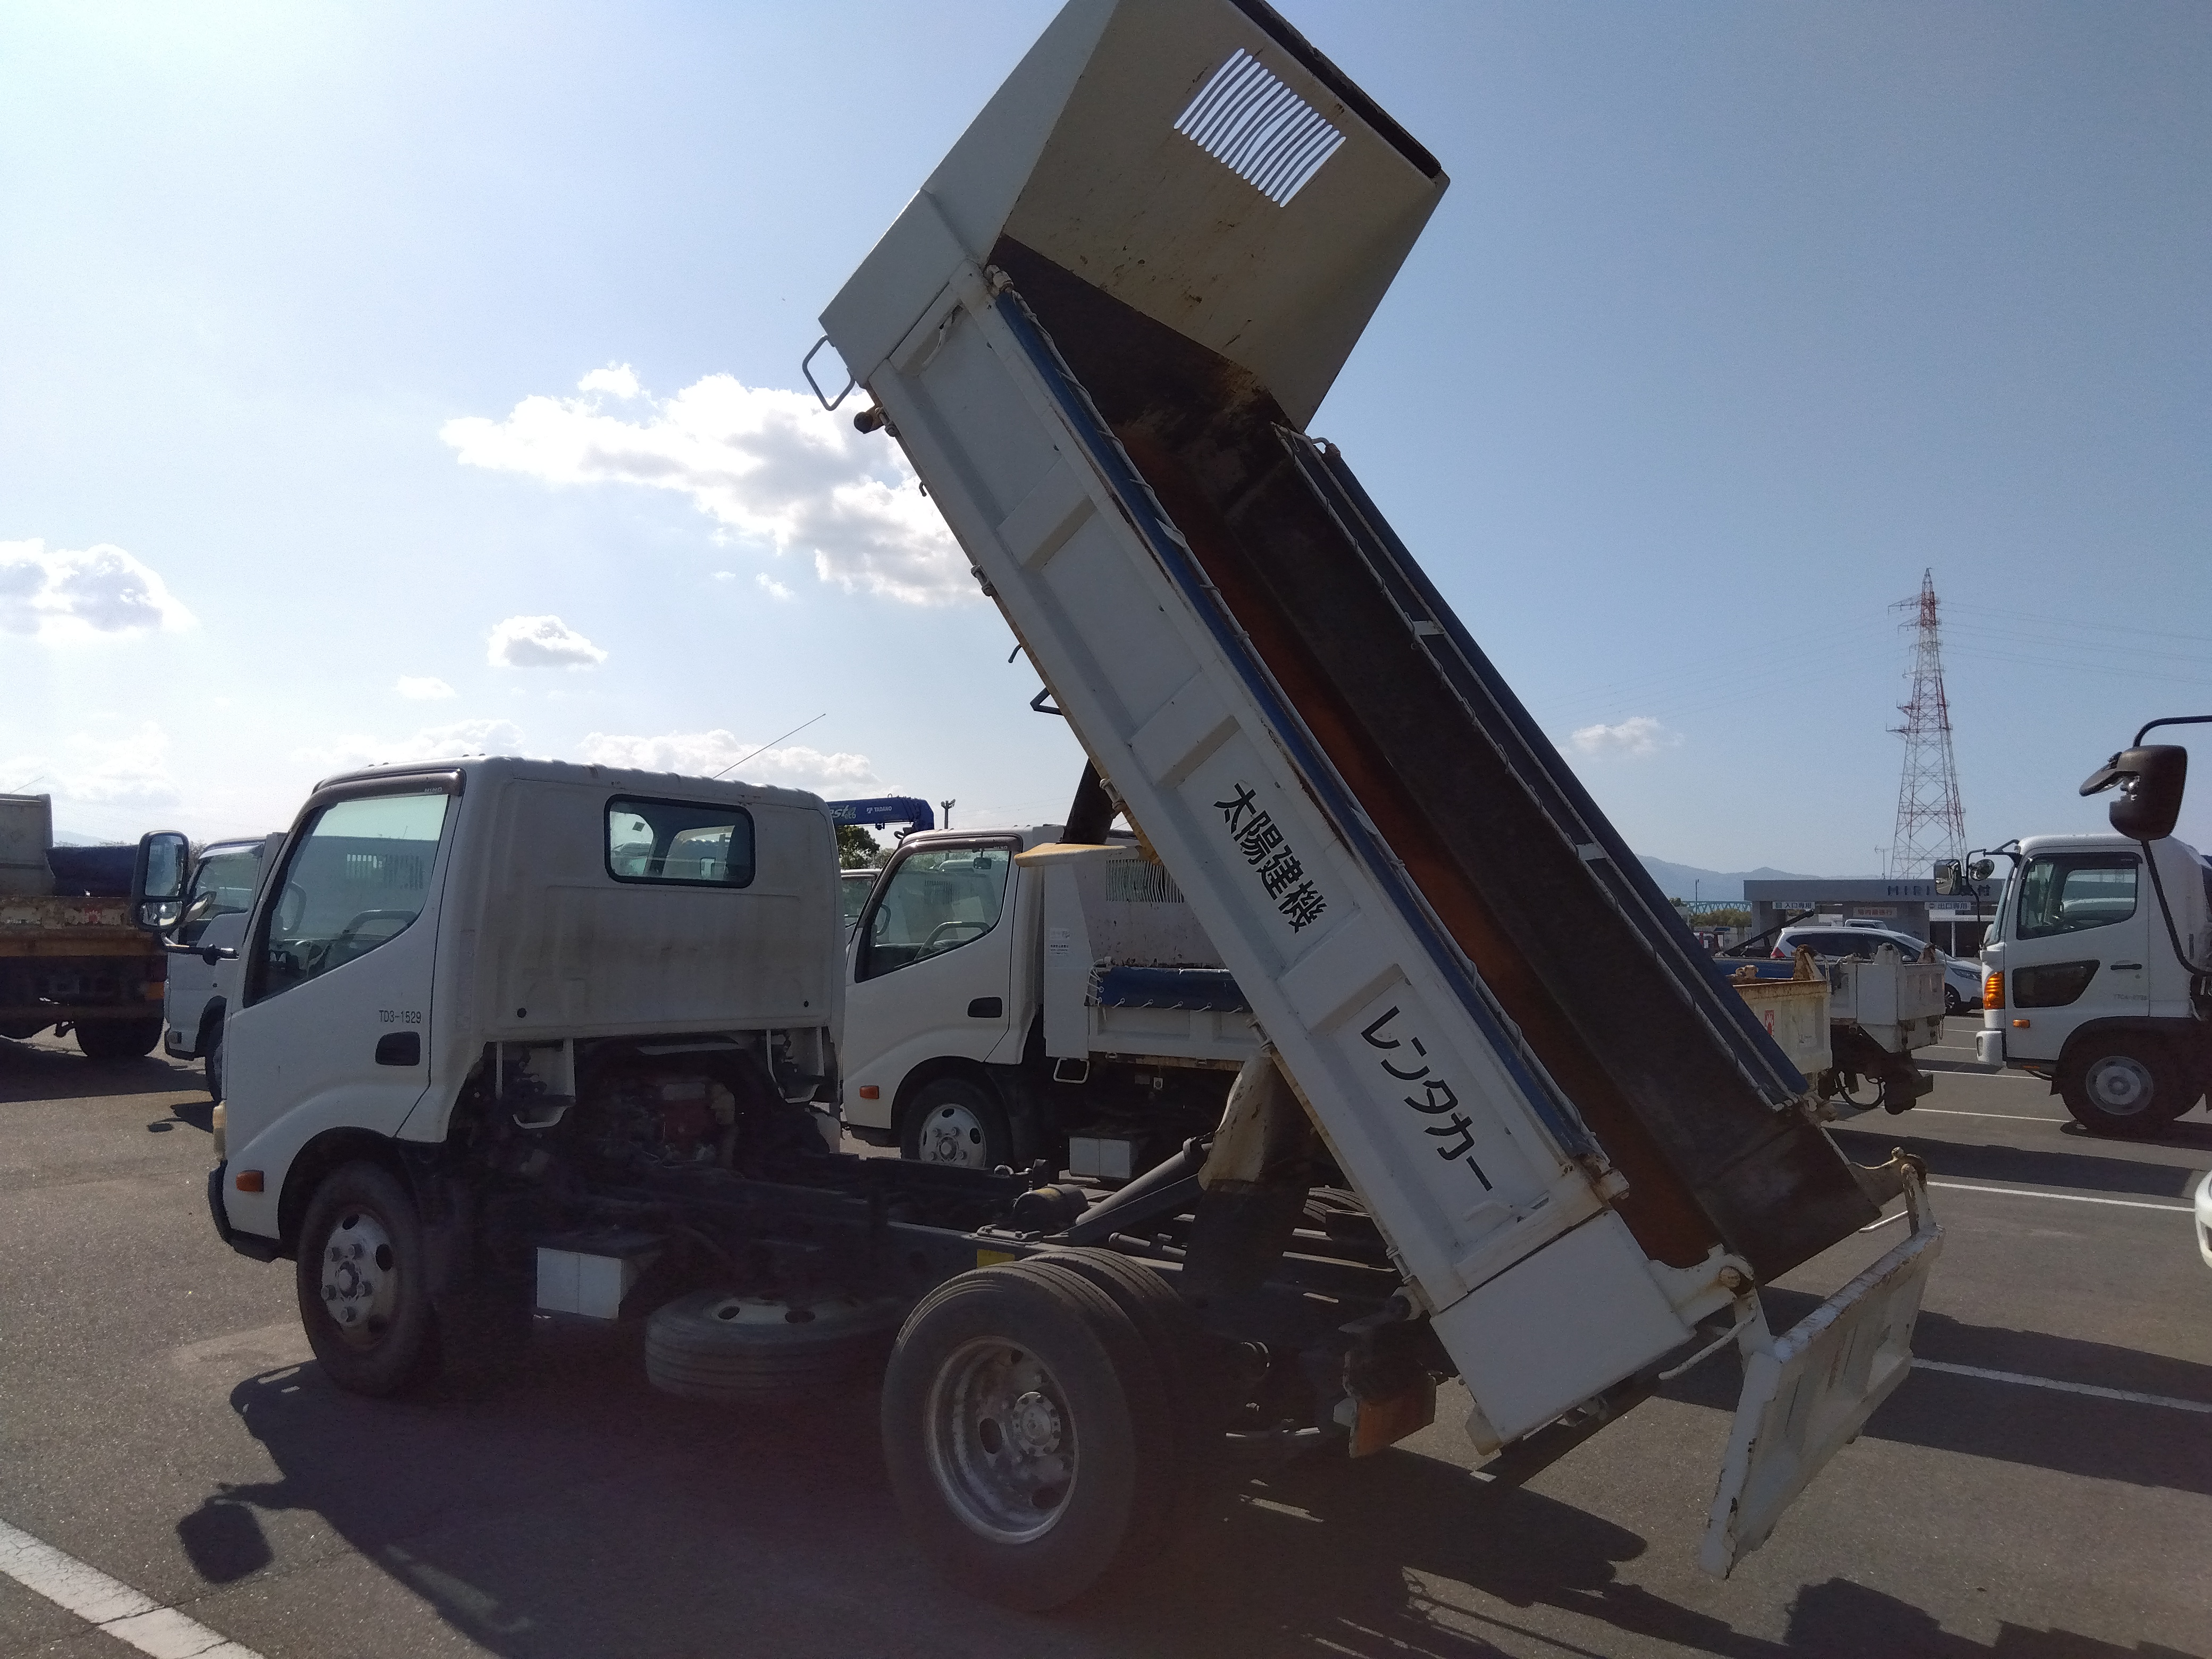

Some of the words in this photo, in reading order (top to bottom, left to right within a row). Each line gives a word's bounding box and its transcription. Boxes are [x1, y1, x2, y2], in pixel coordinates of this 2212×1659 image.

[830, 805, 850, 818] est
[1212, 782, 1329, 934] 太陽建機
[1360, 1006, 1493, 1192] レンタカー
[379, 1010, 421, 1024] TD3-1529
